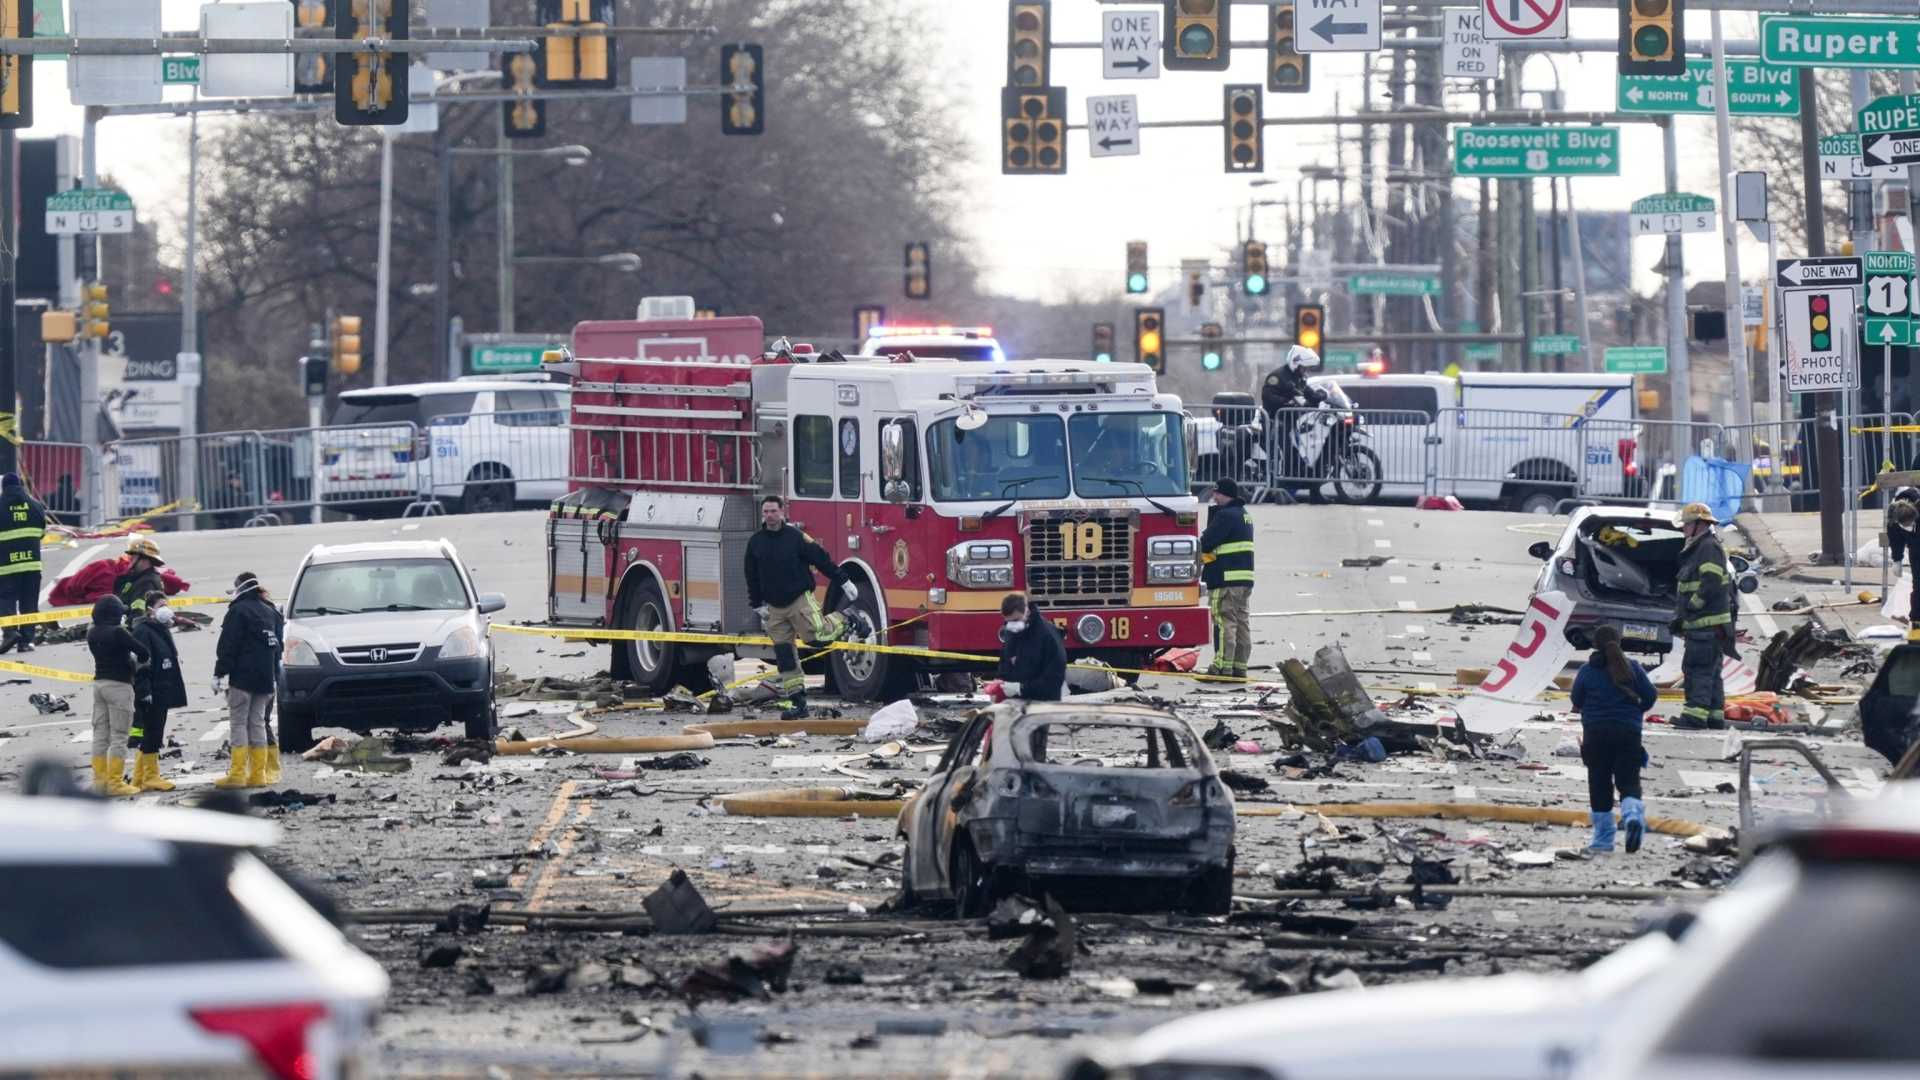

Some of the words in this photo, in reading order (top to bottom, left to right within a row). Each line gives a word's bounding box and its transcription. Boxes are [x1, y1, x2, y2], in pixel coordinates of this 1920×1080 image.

[1112, 18, 1151, 32] ONE
[1111, 37, 1152, 51] WAY
[1453, 33, 1489, 44] TUR
[1778, 27, 1899, 58] Rupert
[1462, 47, 1481, 58] ON
[1457, 61, 1485, 73] RED
[1744, 67, 1792, 85] Blvd
[1648, 90, 1688, 101] NORTH
[1731, 92, 1770, 104] SOUTH
[1095, 101, 1131, 115] ONE
[1095, 118, 1132, 132] WAY
[1462, 132, 1560, 148] Roosevelt
[1568, 132, 1611, 148] Blvd
[1818, 140, 1861, 154] ROOSE
[1482, 156, 1519, 166] NORTH
[1557, 156, 1592, 166] SOUTH
[1825, 161, 1836, 173] N
[56, 216, 66, 228] N
[113, 216, 123, 228] S
[1640, 219, 1650, 231] N
[1697, 216, 1706, 228] S
[1868, 255, 1907, 269] NORTH
[1802, 267, 1825, 279] ONE
[1830, 266, 1854, 277] WAY
[1881, 281, 1892, 308] 1
[1059, 521, 1103, 560] 18
[10, 550, 33, 562] BEALE
[1110, 617, 1130, 640] 18
